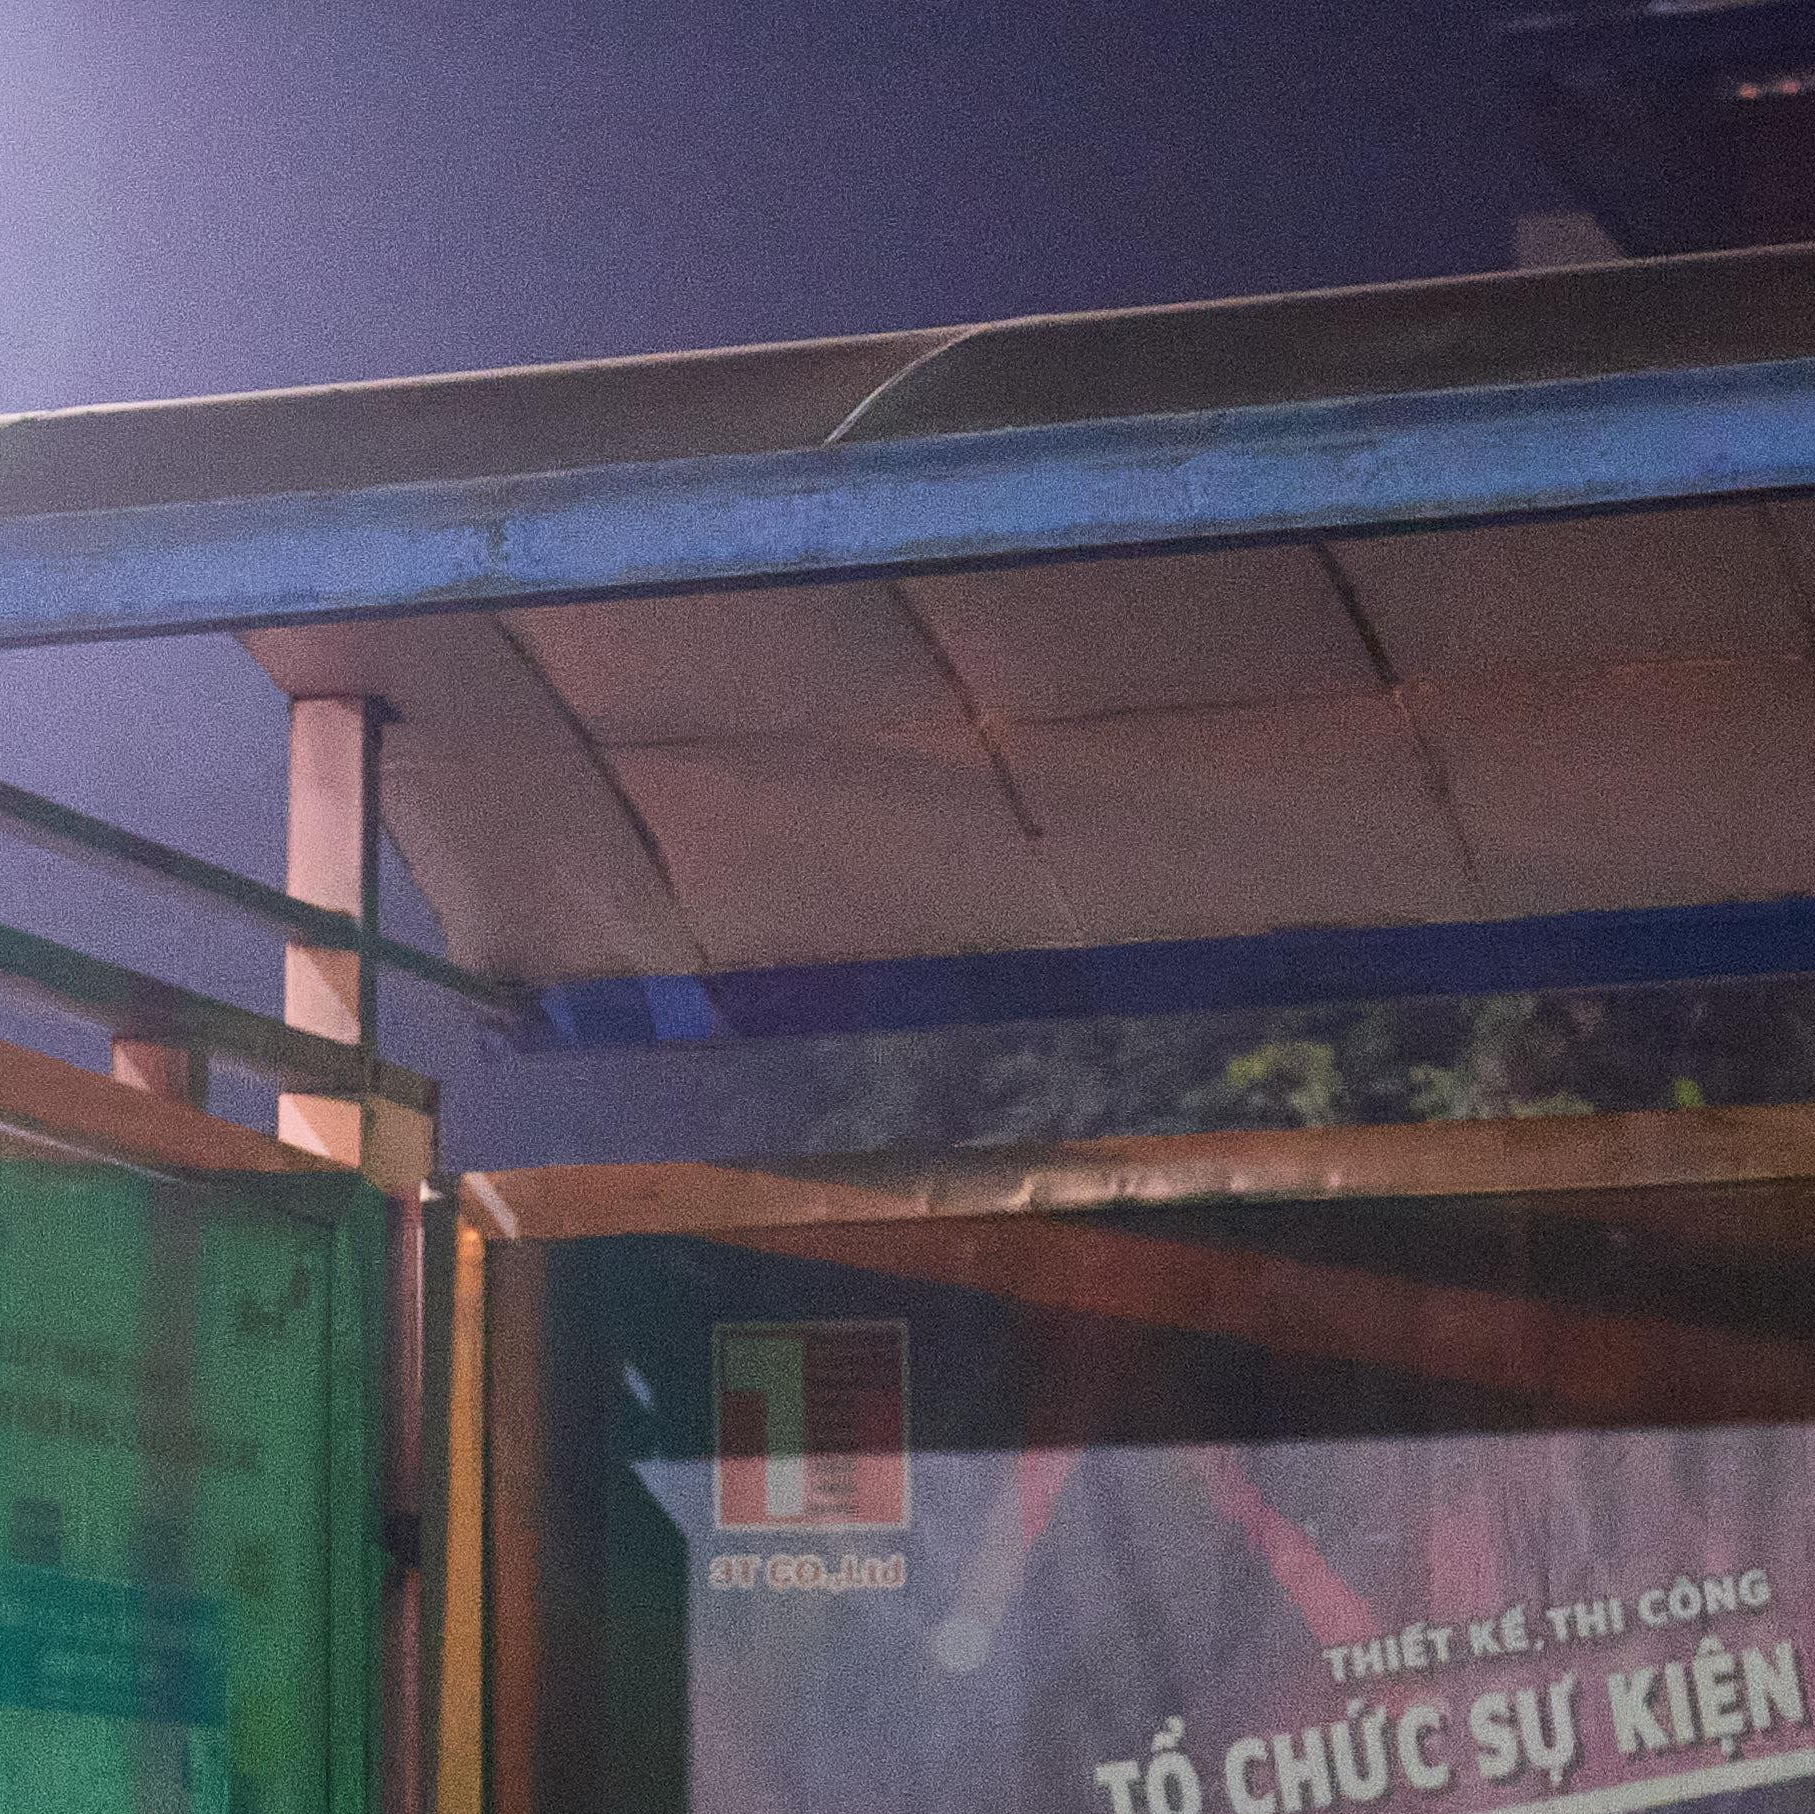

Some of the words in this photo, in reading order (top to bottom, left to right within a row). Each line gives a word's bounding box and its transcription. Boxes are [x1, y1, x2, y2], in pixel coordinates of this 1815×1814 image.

[708, 1554, 761, 1590] 3T
[1322, 1621, 1452, 1684] THIẾT
[1545, 1599, 1625, 1644] THI
[1637, 1569, 1772, 1629] CÔNG
[1467, 1670, 1579, 1787] SỰ
[1608, 1637, 1806, 1756] KIỆN
